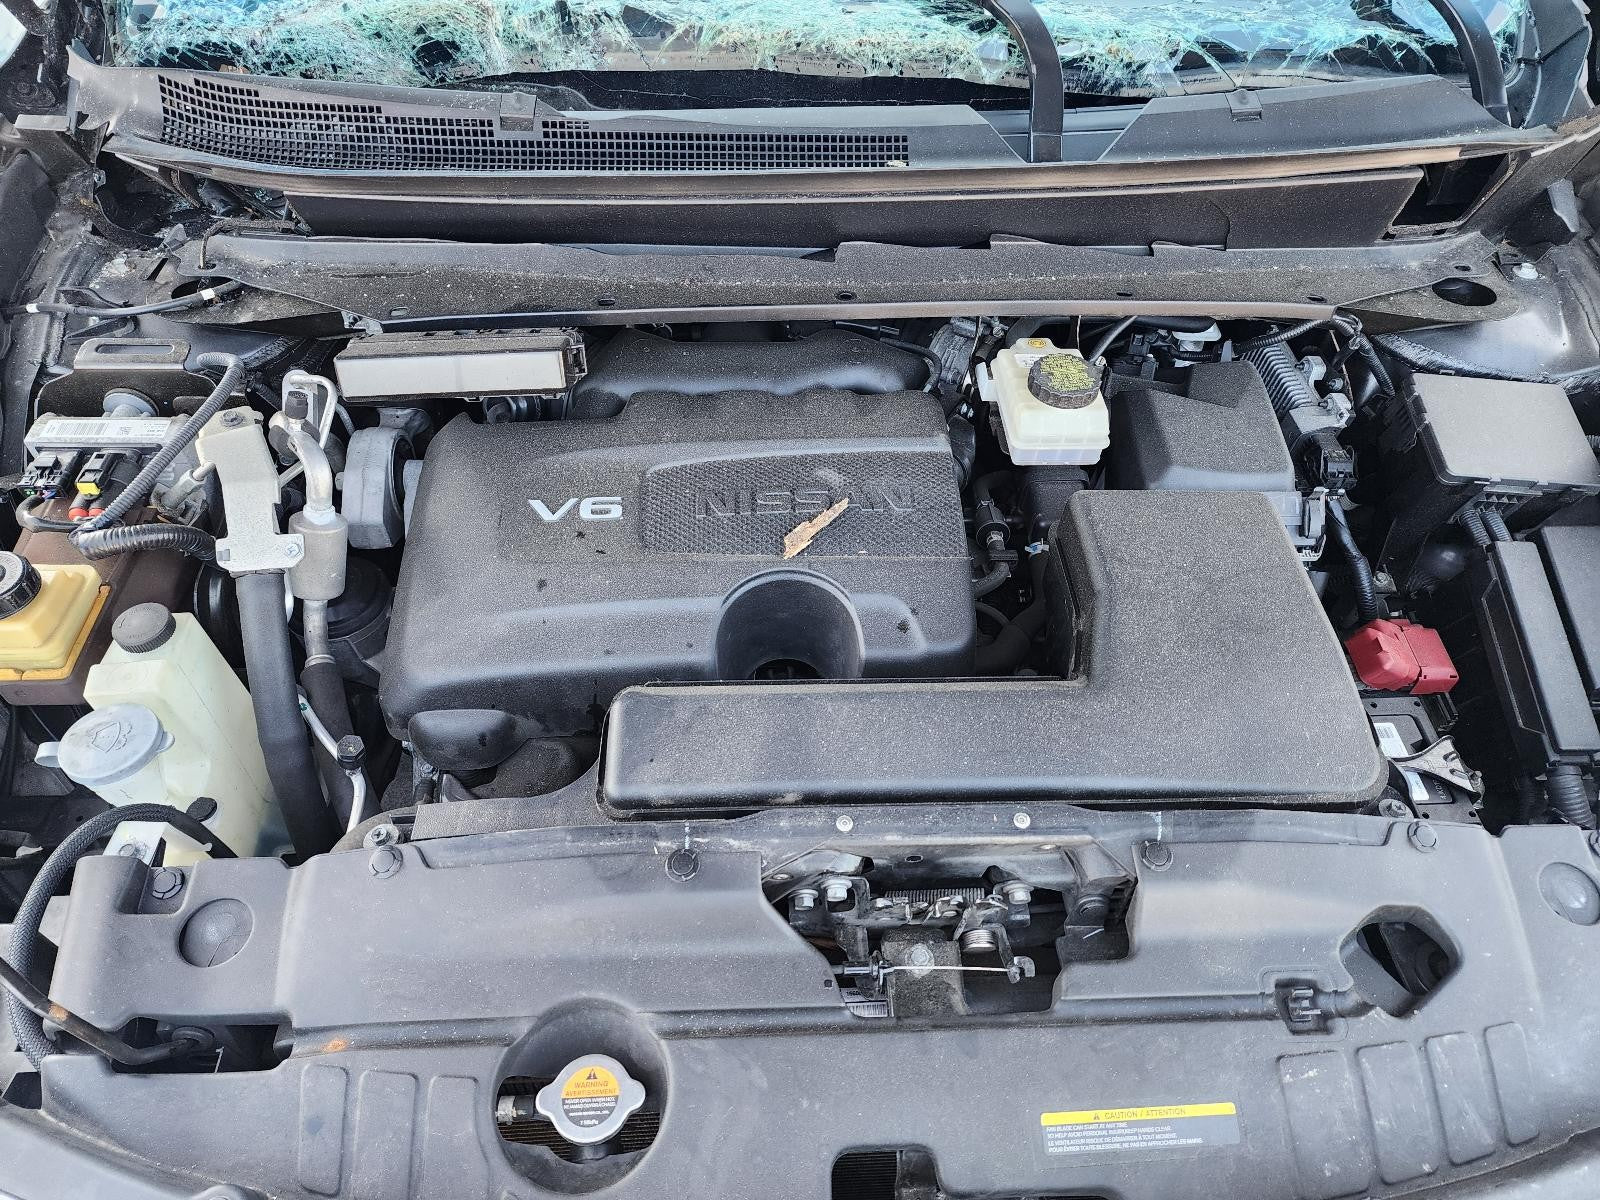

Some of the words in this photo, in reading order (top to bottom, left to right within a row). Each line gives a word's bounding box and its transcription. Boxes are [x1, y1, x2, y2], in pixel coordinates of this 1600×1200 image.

[528, 496, 623, 523] V6
[695, 488, 916, 518] NISSAN
[566, 1088, 616, 1096] AVERTISSEMENT
[1104, 1110, 1138, 1119] CAUTION
[1146, 1108, 1186, 1117] ATTENTION
